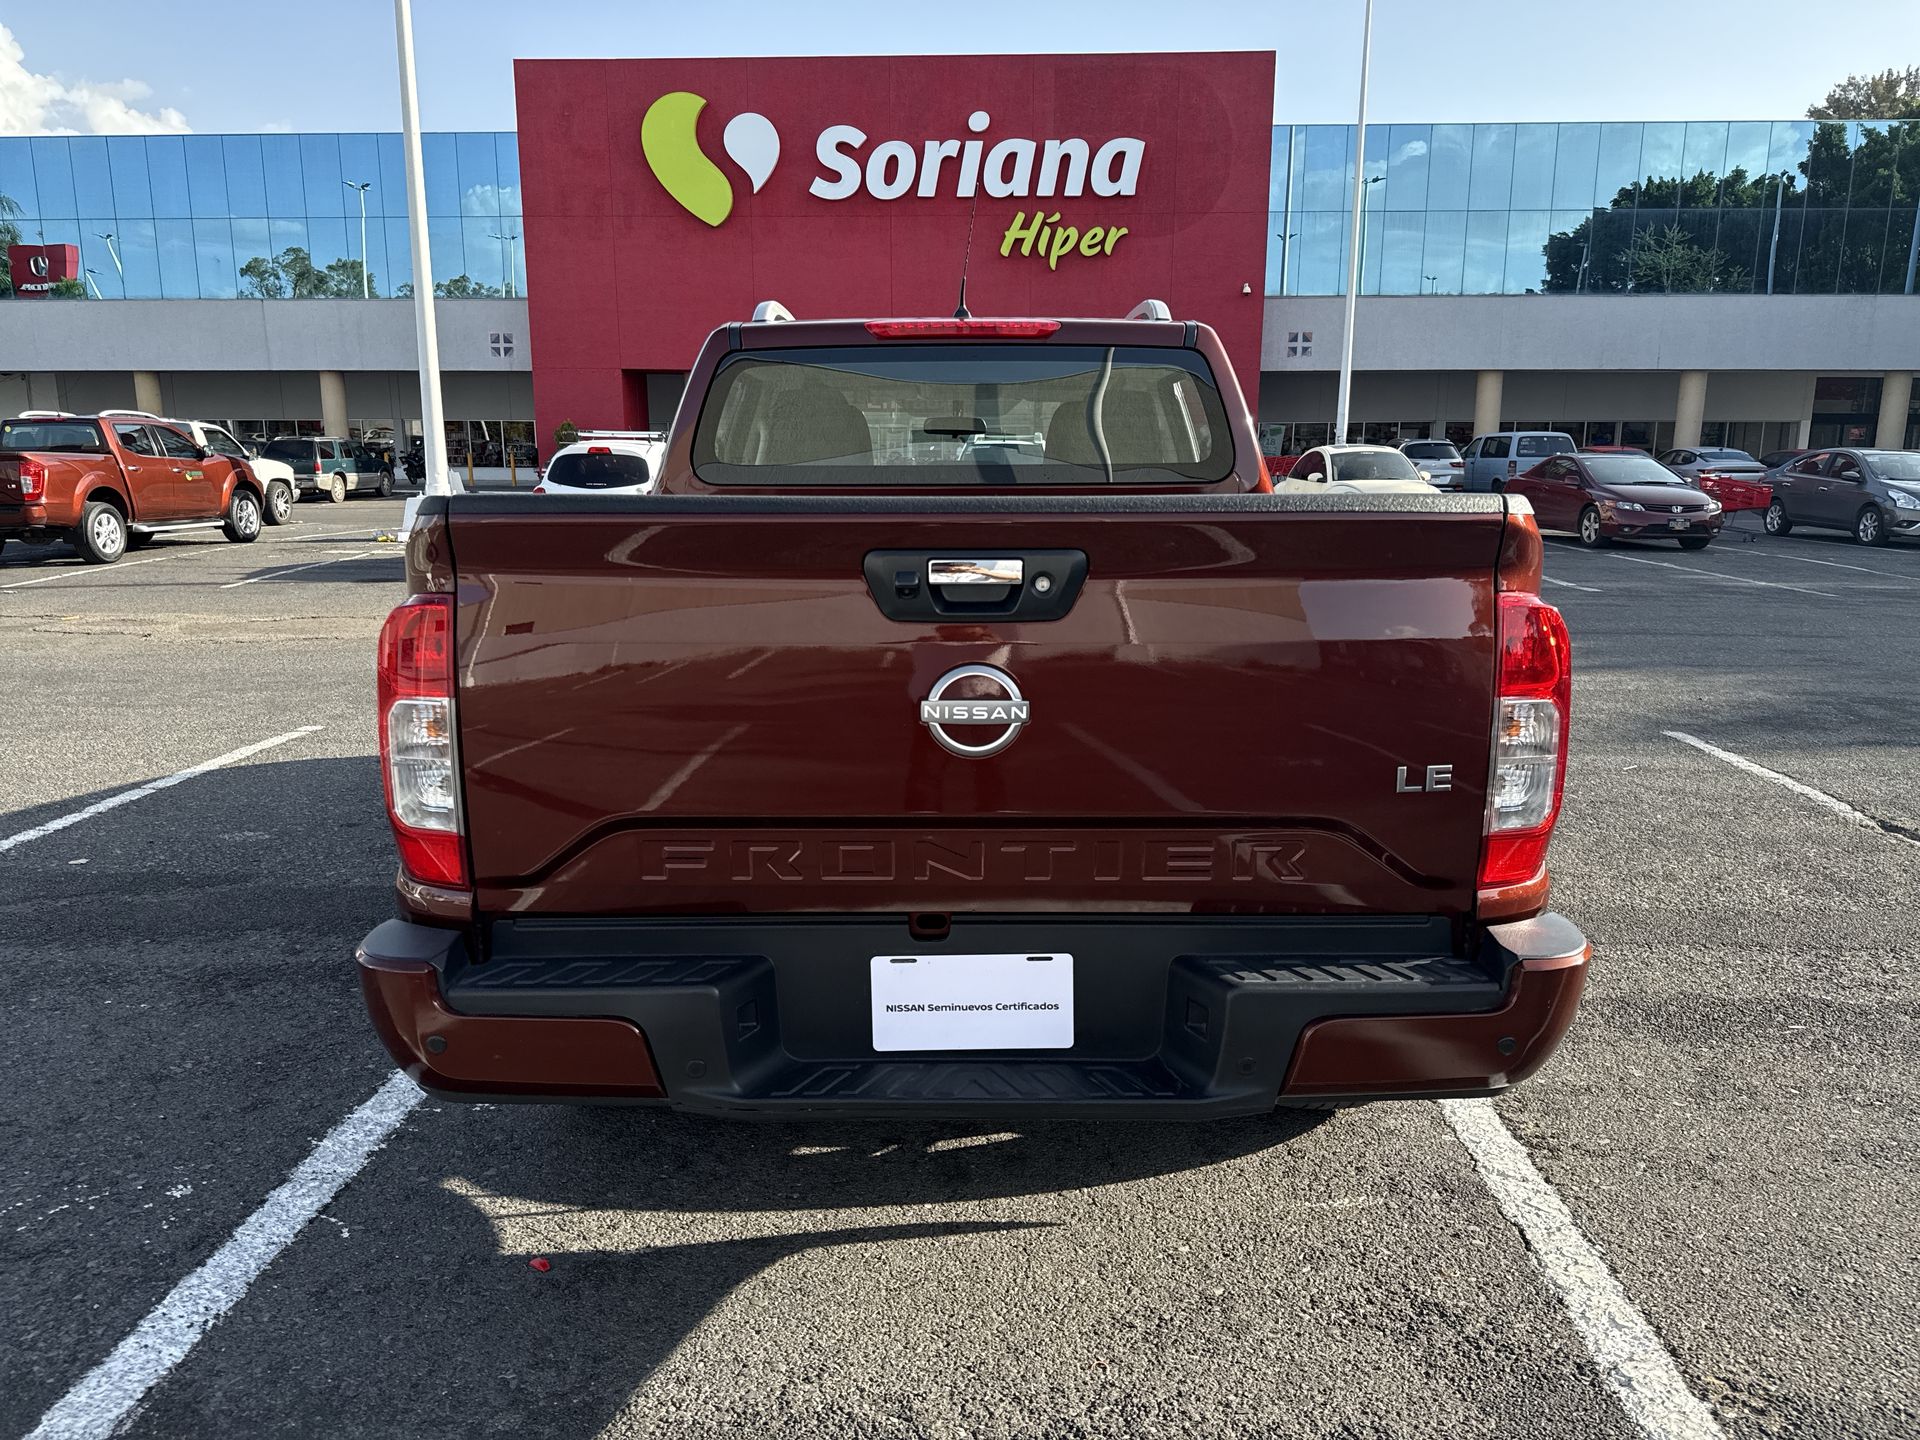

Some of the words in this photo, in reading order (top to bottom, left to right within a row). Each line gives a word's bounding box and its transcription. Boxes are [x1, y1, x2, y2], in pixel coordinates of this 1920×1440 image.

[808, 110, 1146, 201] Soriana
[999, 211, 1129, 271] Híper
[923, 705, 1028, 720] NISSAN
[1396, 764, 1453, 793] LE
[640, 839, 1308, 881] FRONTIER
[885, 1004, 926, 1013] NISSAN
[927, 1003, 993, 1013] Seminuevos
[995, 1001, 1060, 1011] Certificados
